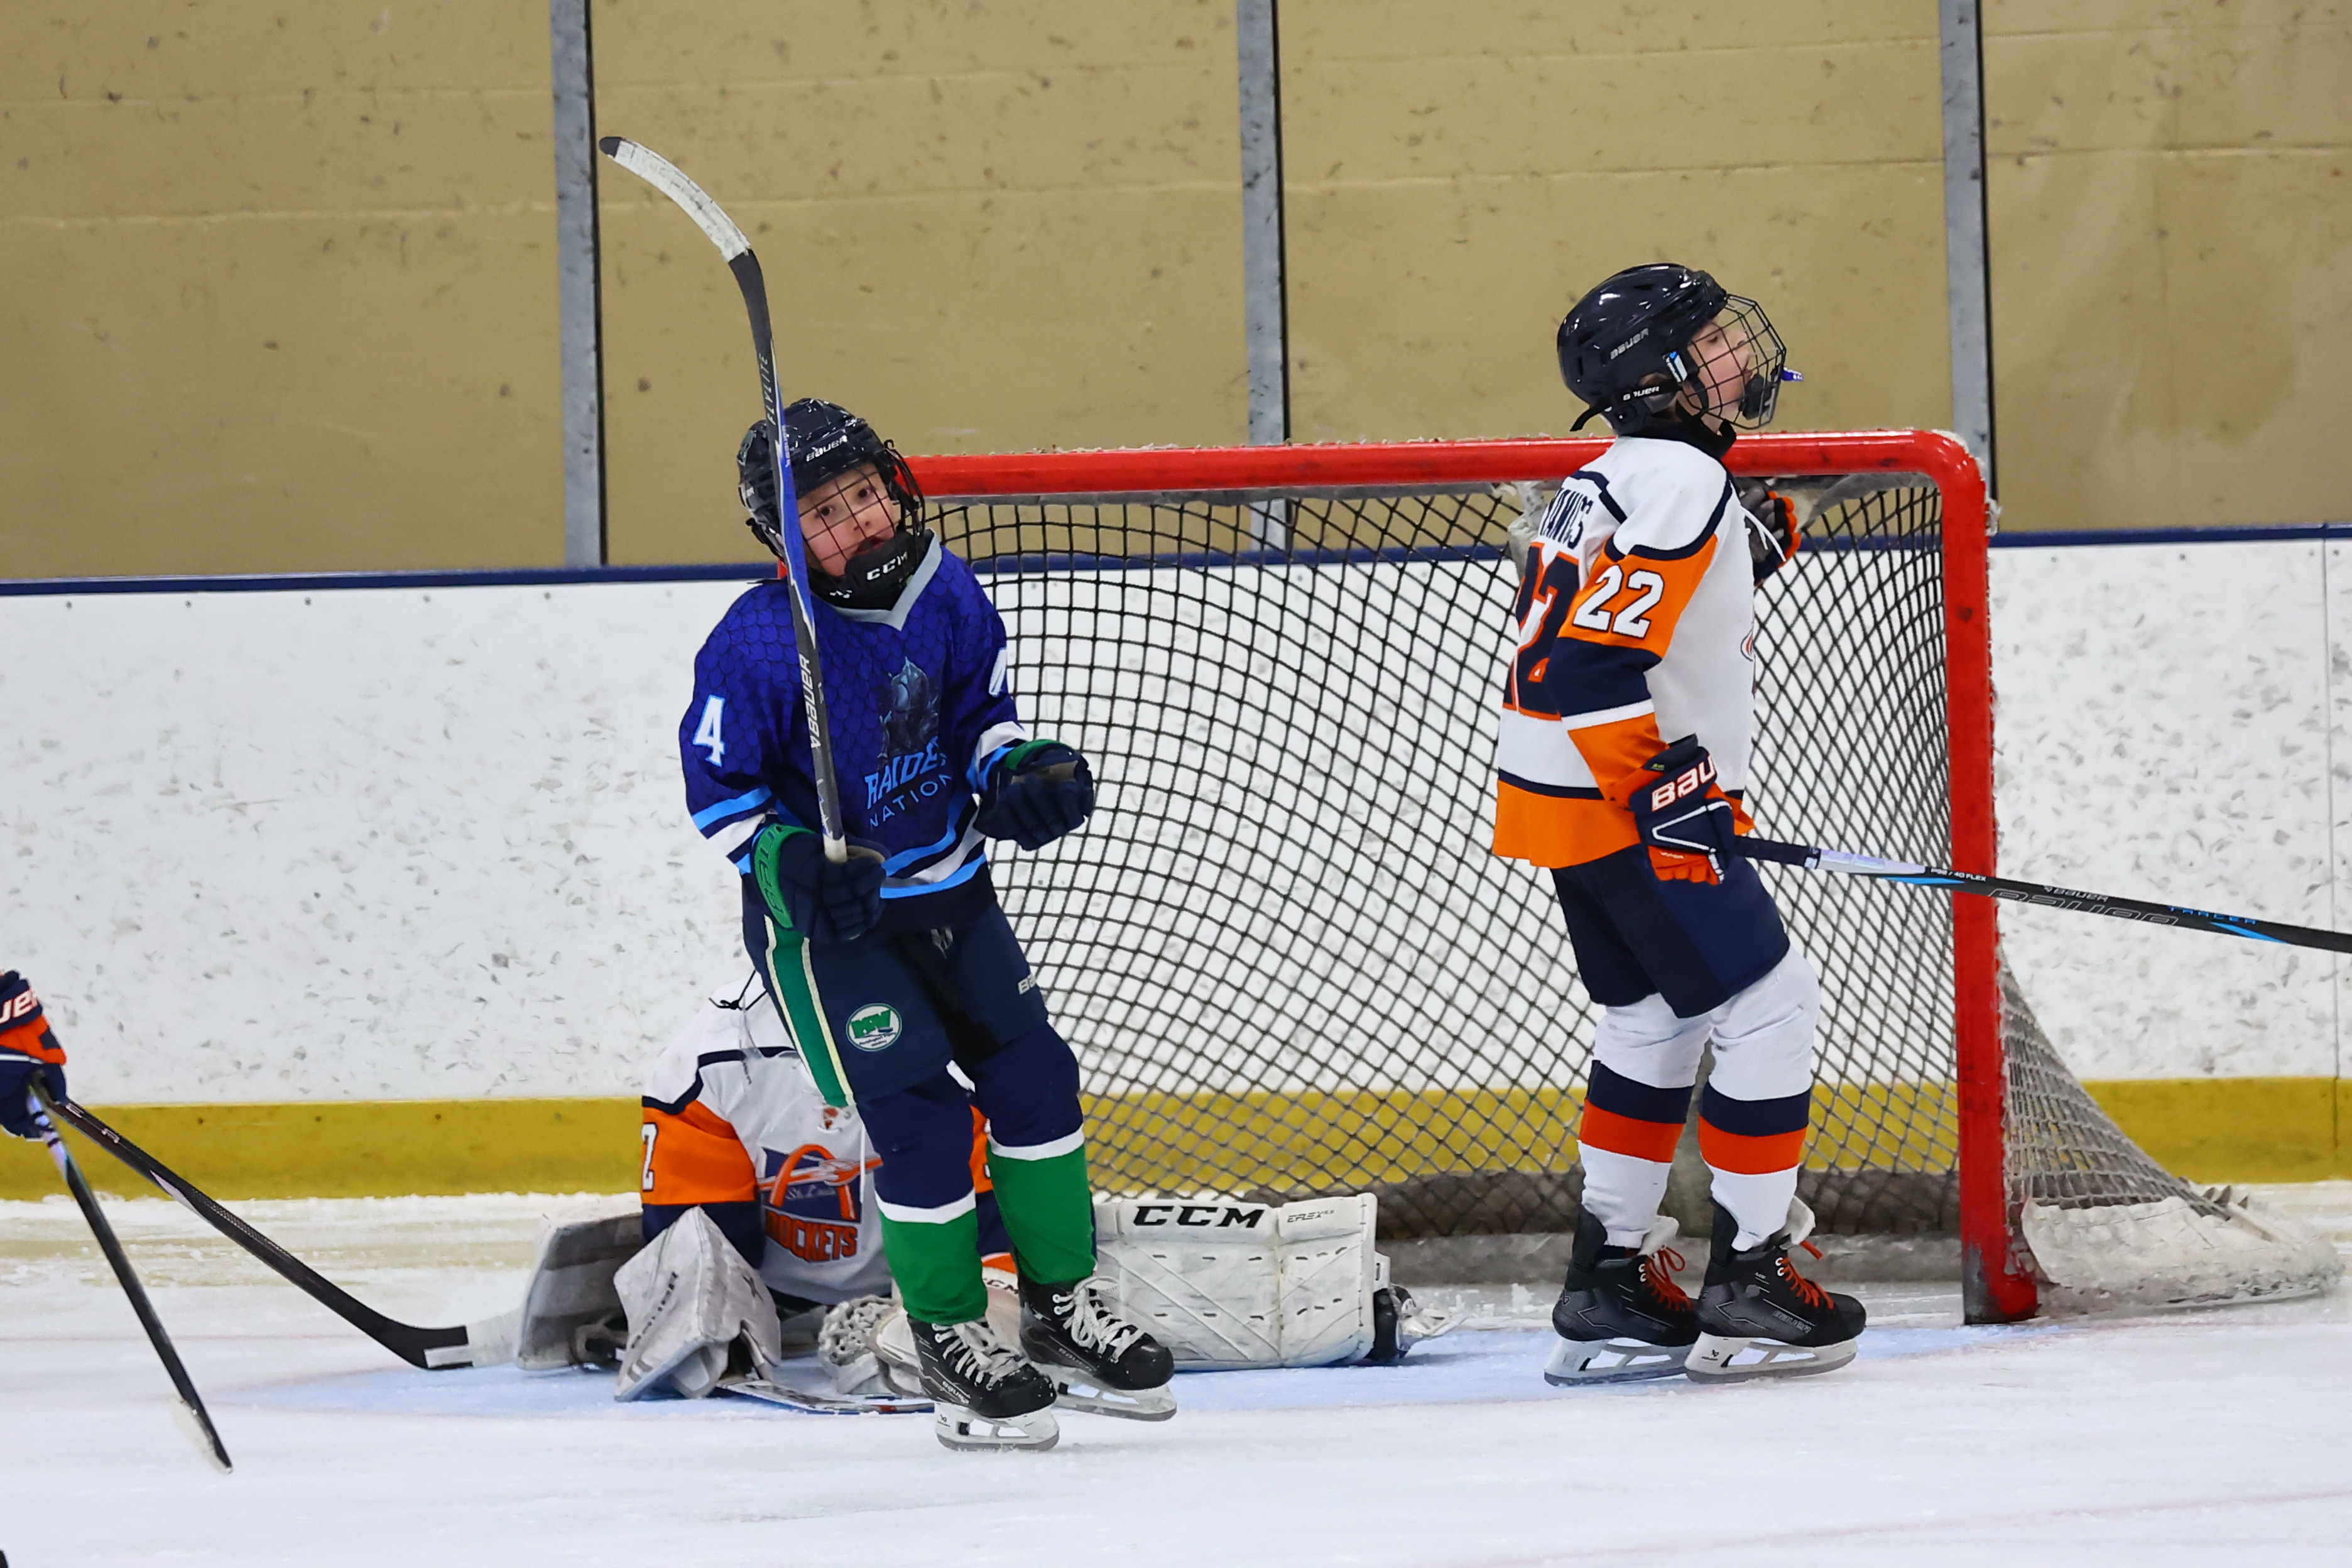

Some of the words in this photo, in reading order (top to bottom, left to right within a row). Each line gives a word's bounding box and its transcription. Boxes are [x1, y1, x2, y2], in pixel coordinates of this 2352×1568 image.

[1610, 327, 1649, 360] BAUER
[759, 353, 776, 426] FLYLITE
[866, 551, 908, 580] CCM
[1572, 564, 1665, 640] 22
[798, 653, 820, 738] BAUER
[692, 694, 725, 768] 4
[1651, 754, 1716, 812] BAU
[1966, 873, 1986, 882] FLEX
[1133, 1206, 1265, 1228] CCM
